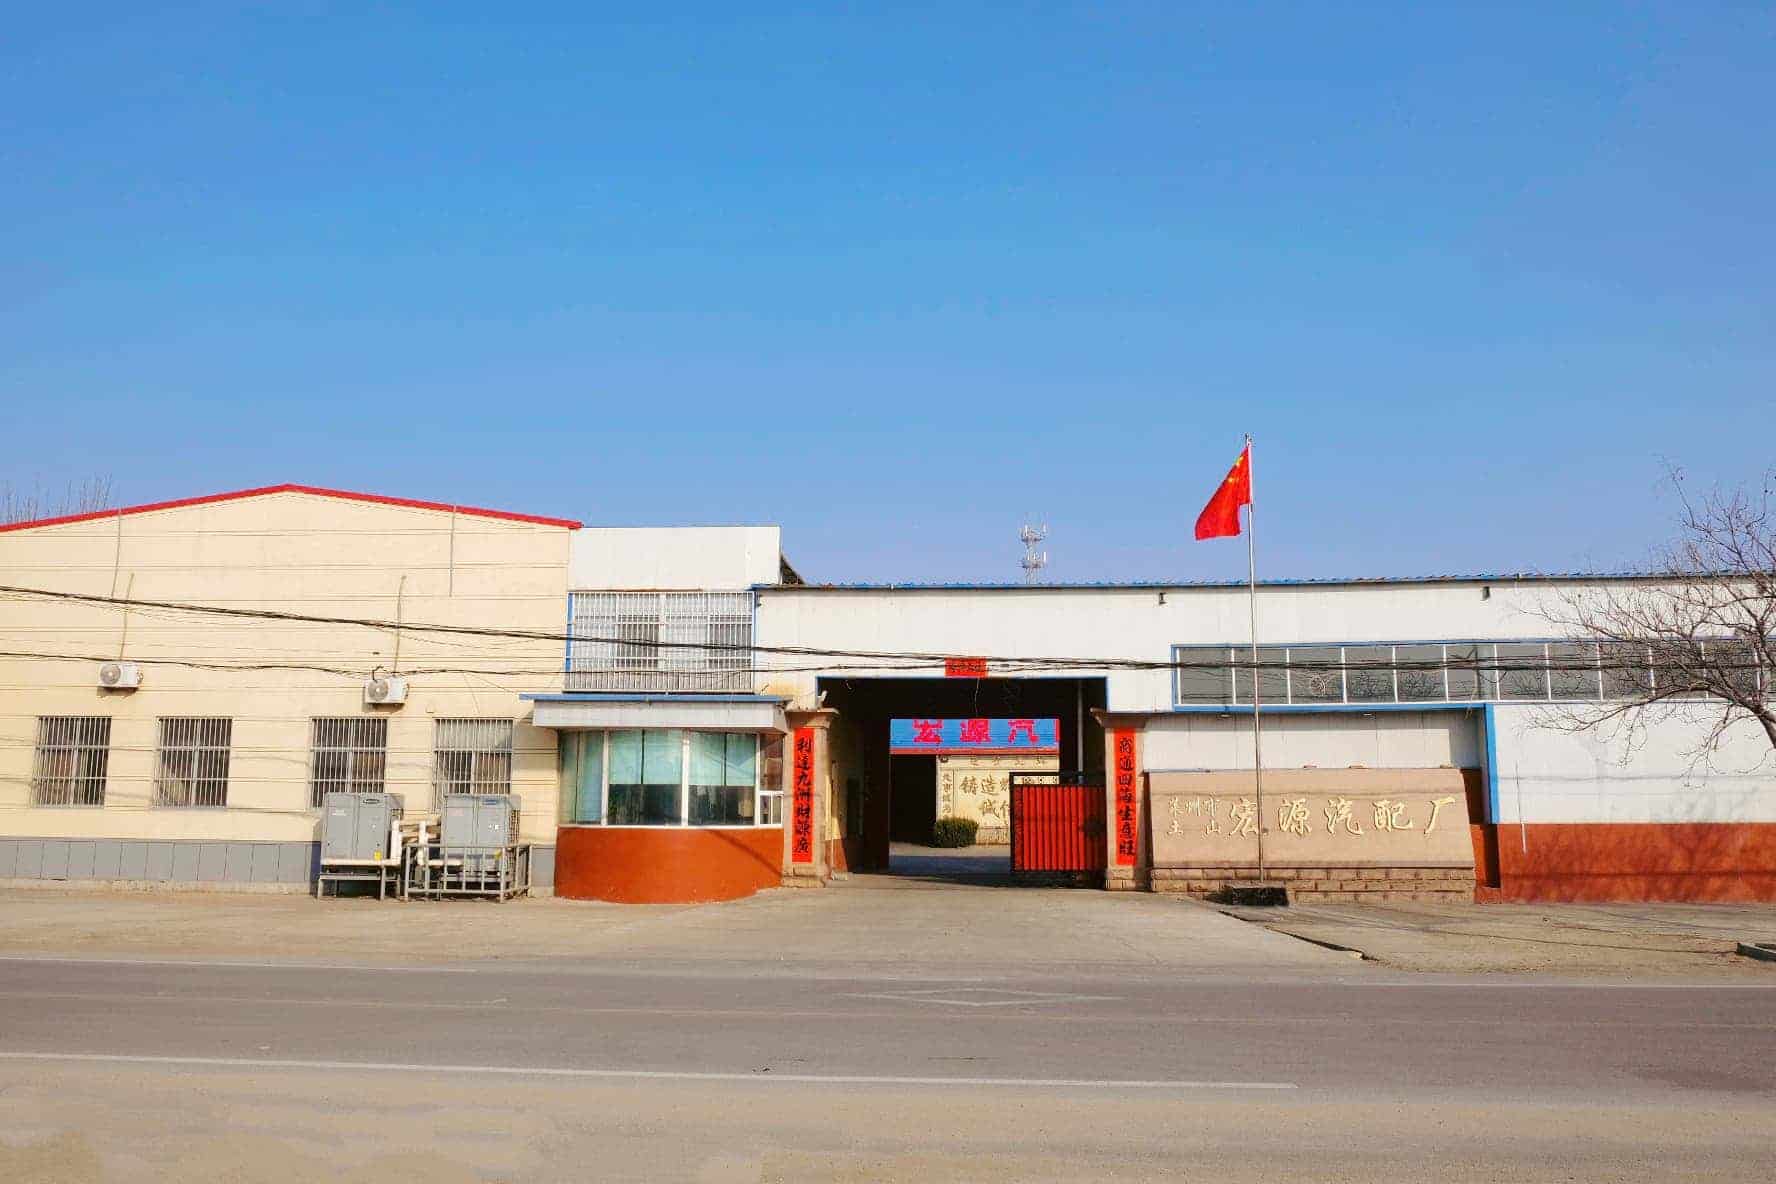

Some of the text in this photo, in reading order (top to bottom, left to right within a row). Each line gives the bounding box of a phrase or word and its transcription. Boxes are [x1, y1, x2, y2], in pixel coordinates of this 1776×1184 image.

[912, 719, 1060, 744] 宏源汽
[1227, 796, 1456, 837] 宏源汽配厂
